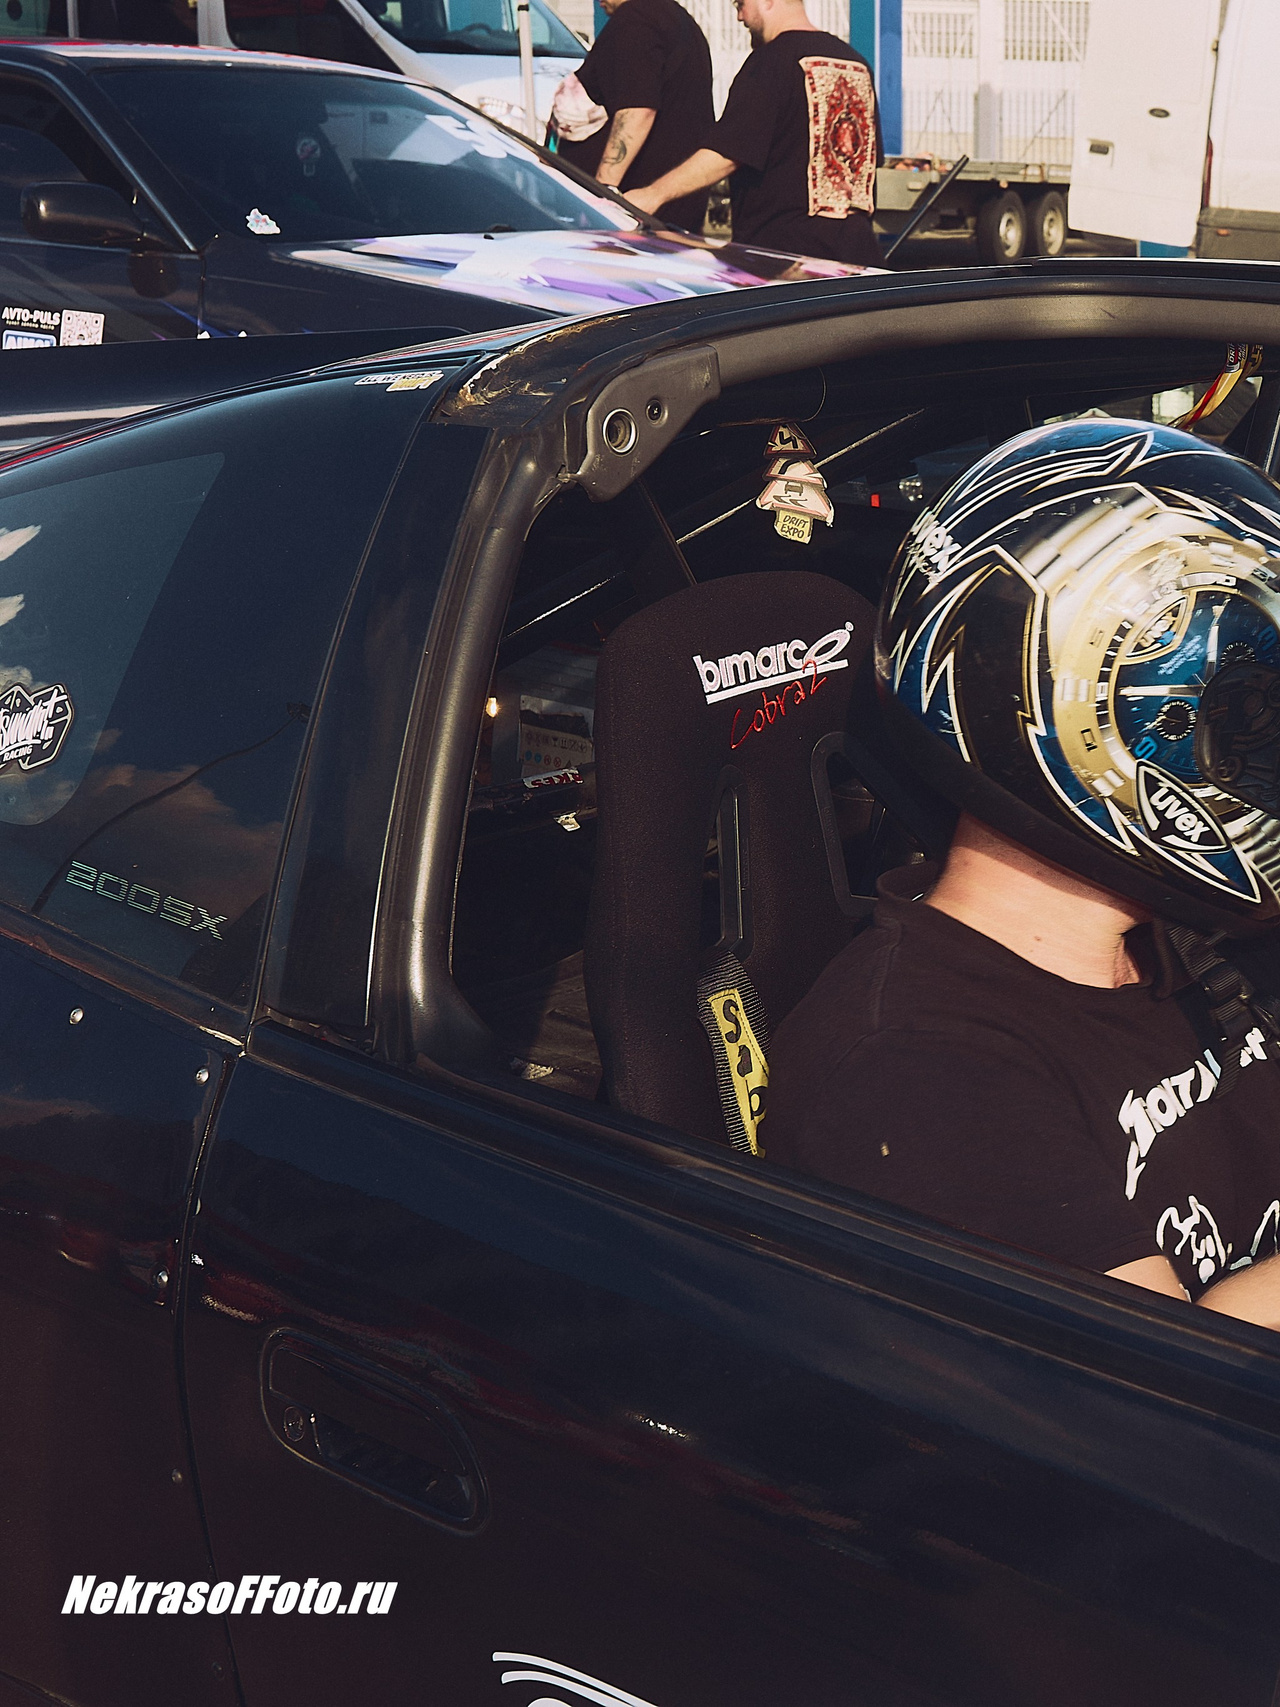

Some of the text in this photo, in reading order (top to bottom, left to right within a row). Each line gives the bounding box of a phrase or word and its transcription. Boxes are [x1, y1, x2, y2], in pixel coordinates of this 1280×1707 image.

[2, 307, 60, 326] AVTO-PULS
[780, 524, 805, 539] EXPO
[783, 515, 808, 529] DRIFT
[693, 621, 854, 694] bimarco
[730, 658, 828, 749] Cobra 2
[2, 745, 34, 762] RACING
[1149, 786, 1211, 843] uvex
[65, 860, 228, 941] 200SX
